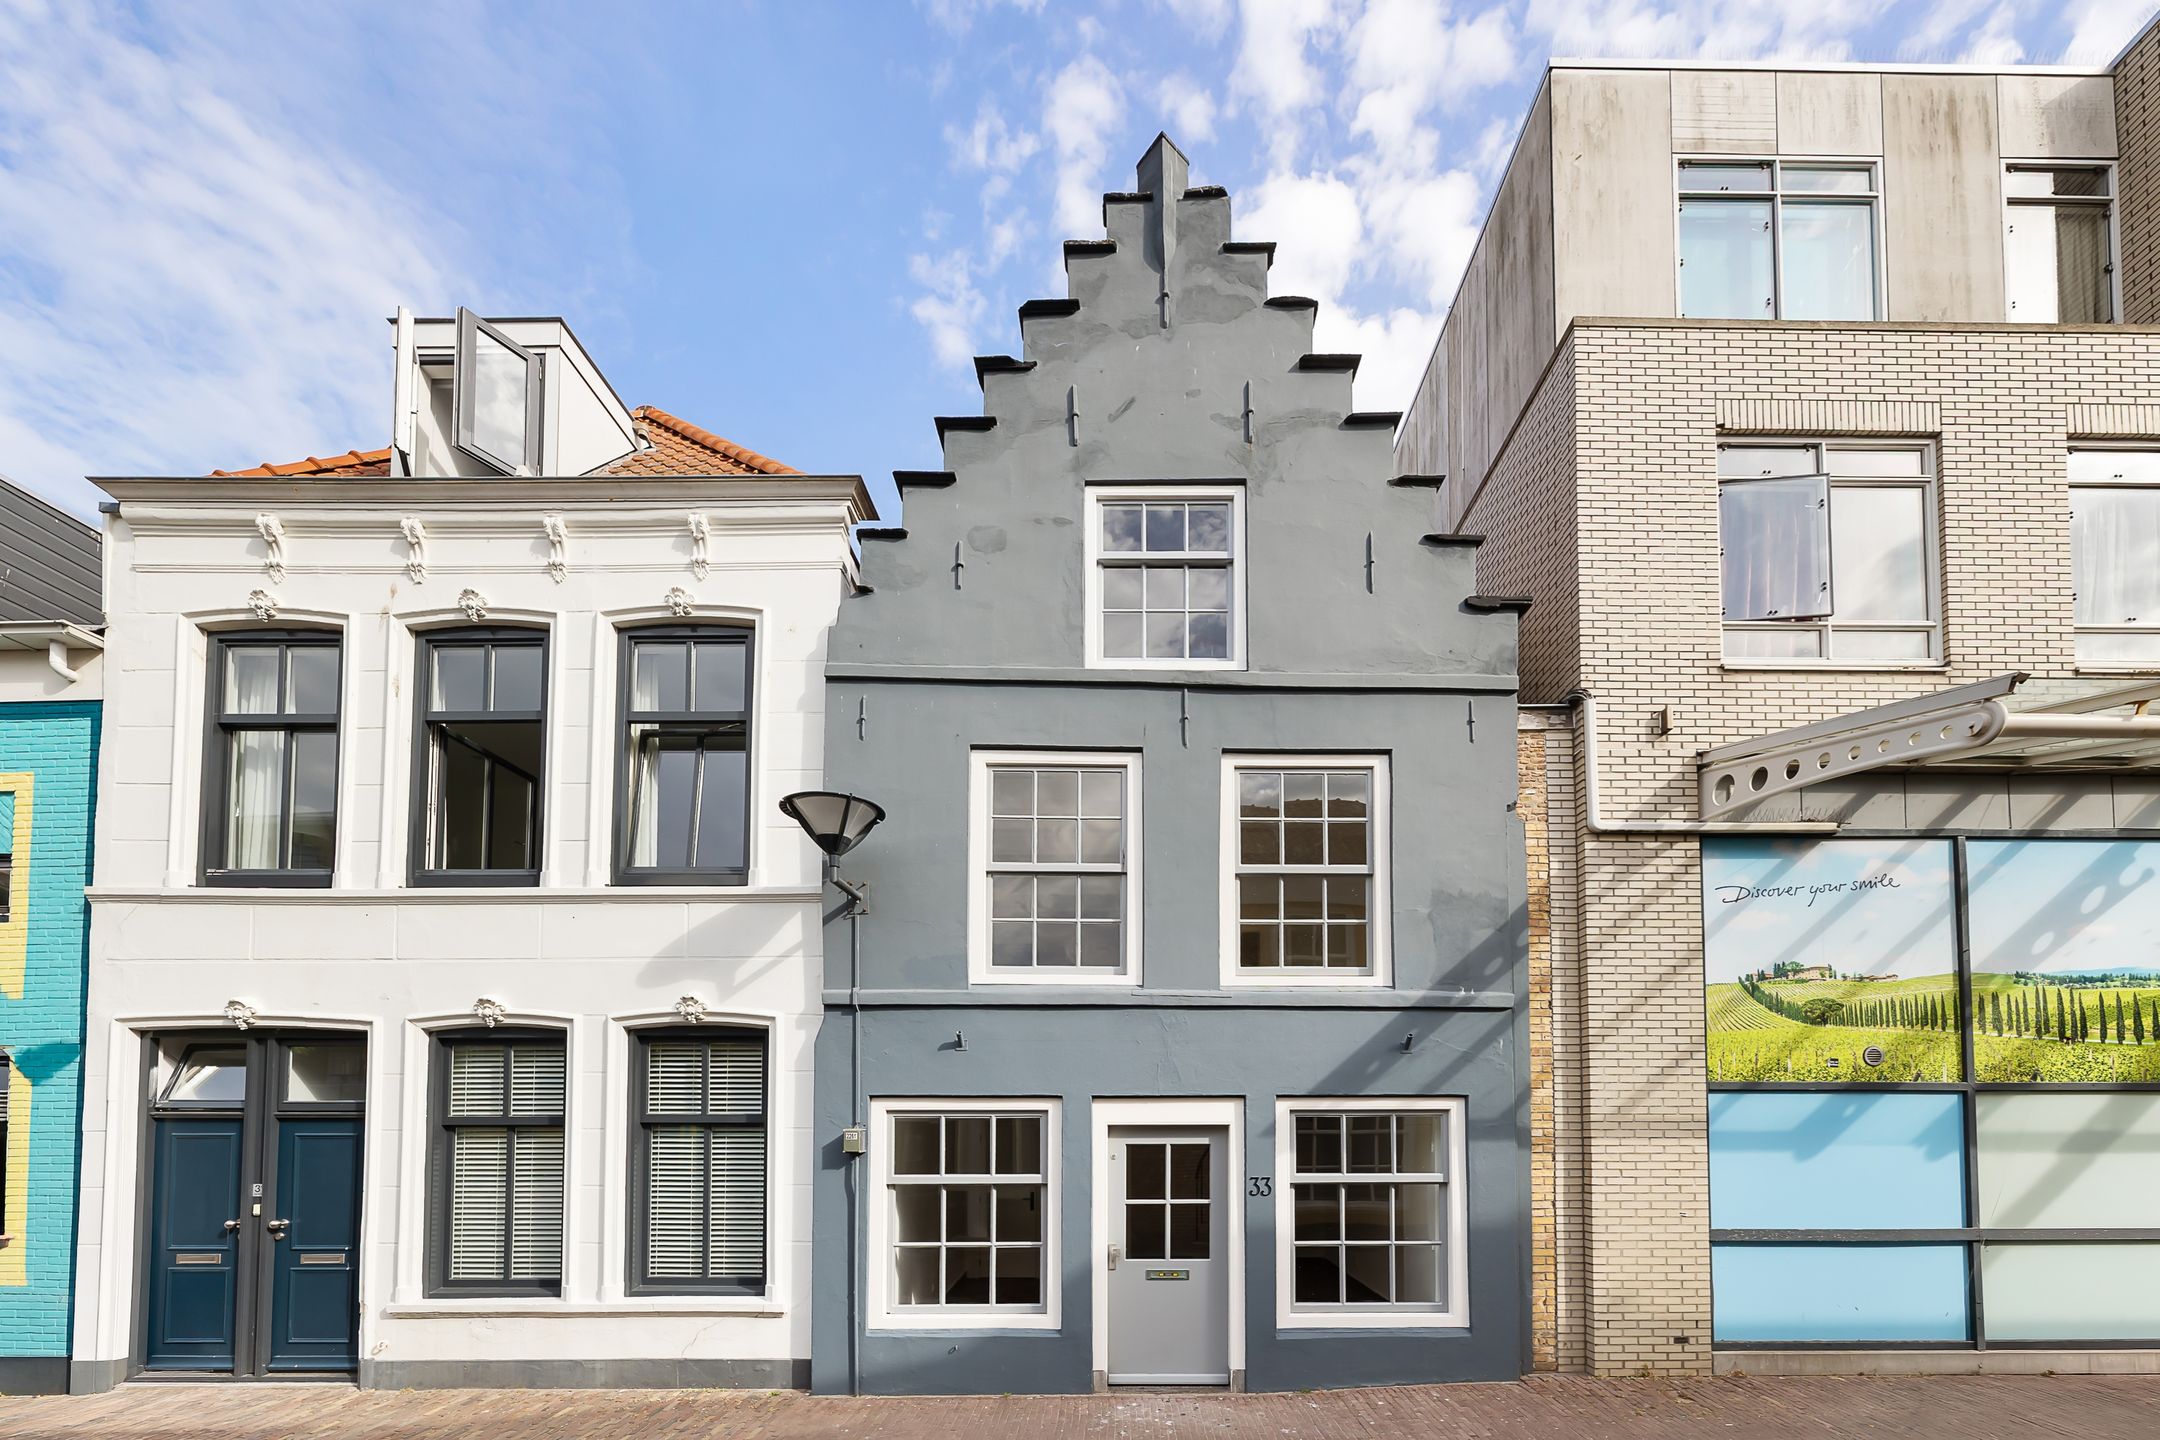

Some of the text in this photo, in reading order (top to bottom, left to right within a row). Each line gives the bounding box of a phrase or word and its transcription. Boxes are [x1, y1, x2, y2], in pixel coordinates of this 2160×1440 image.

[1714, 873, 1901, 908] Discover your smile
[1248, 1176, 1272, 1197] 33
